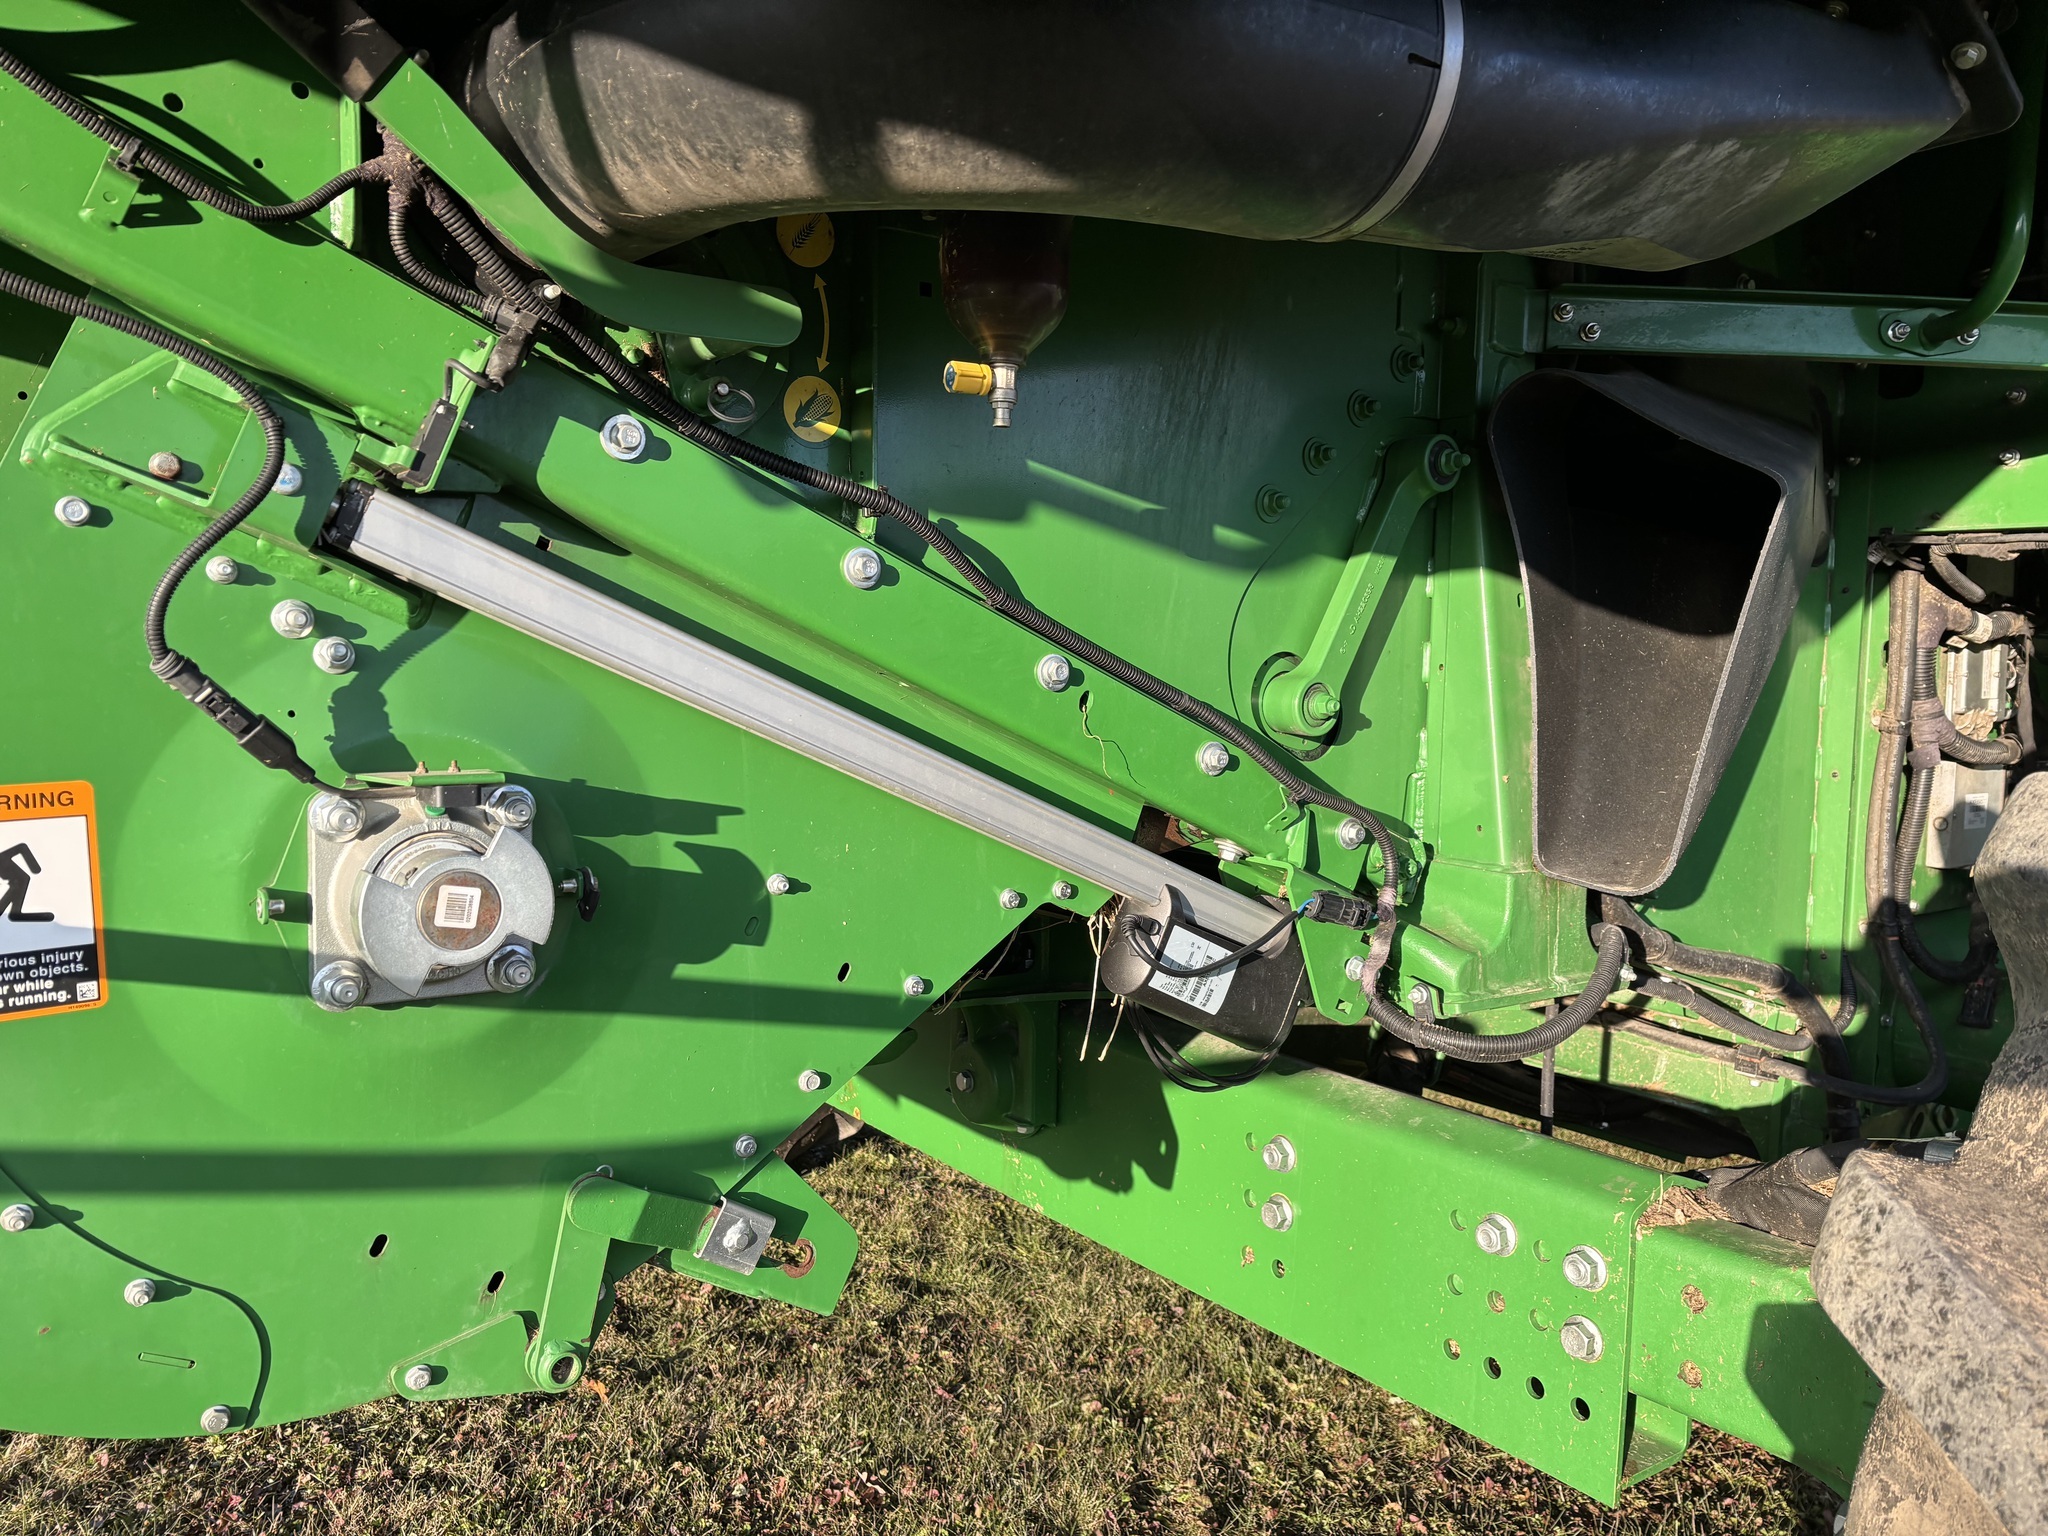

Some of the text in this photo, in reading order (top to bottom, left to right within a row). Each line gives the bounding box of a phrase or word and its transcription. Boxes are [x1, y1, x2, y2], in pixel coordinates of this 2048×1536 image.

[41, 950, 84, 965] injury
[29, 963, 89, 978] objects.
[13, 979, 54, 993] while
[8, 990, 72, 1007] running.
